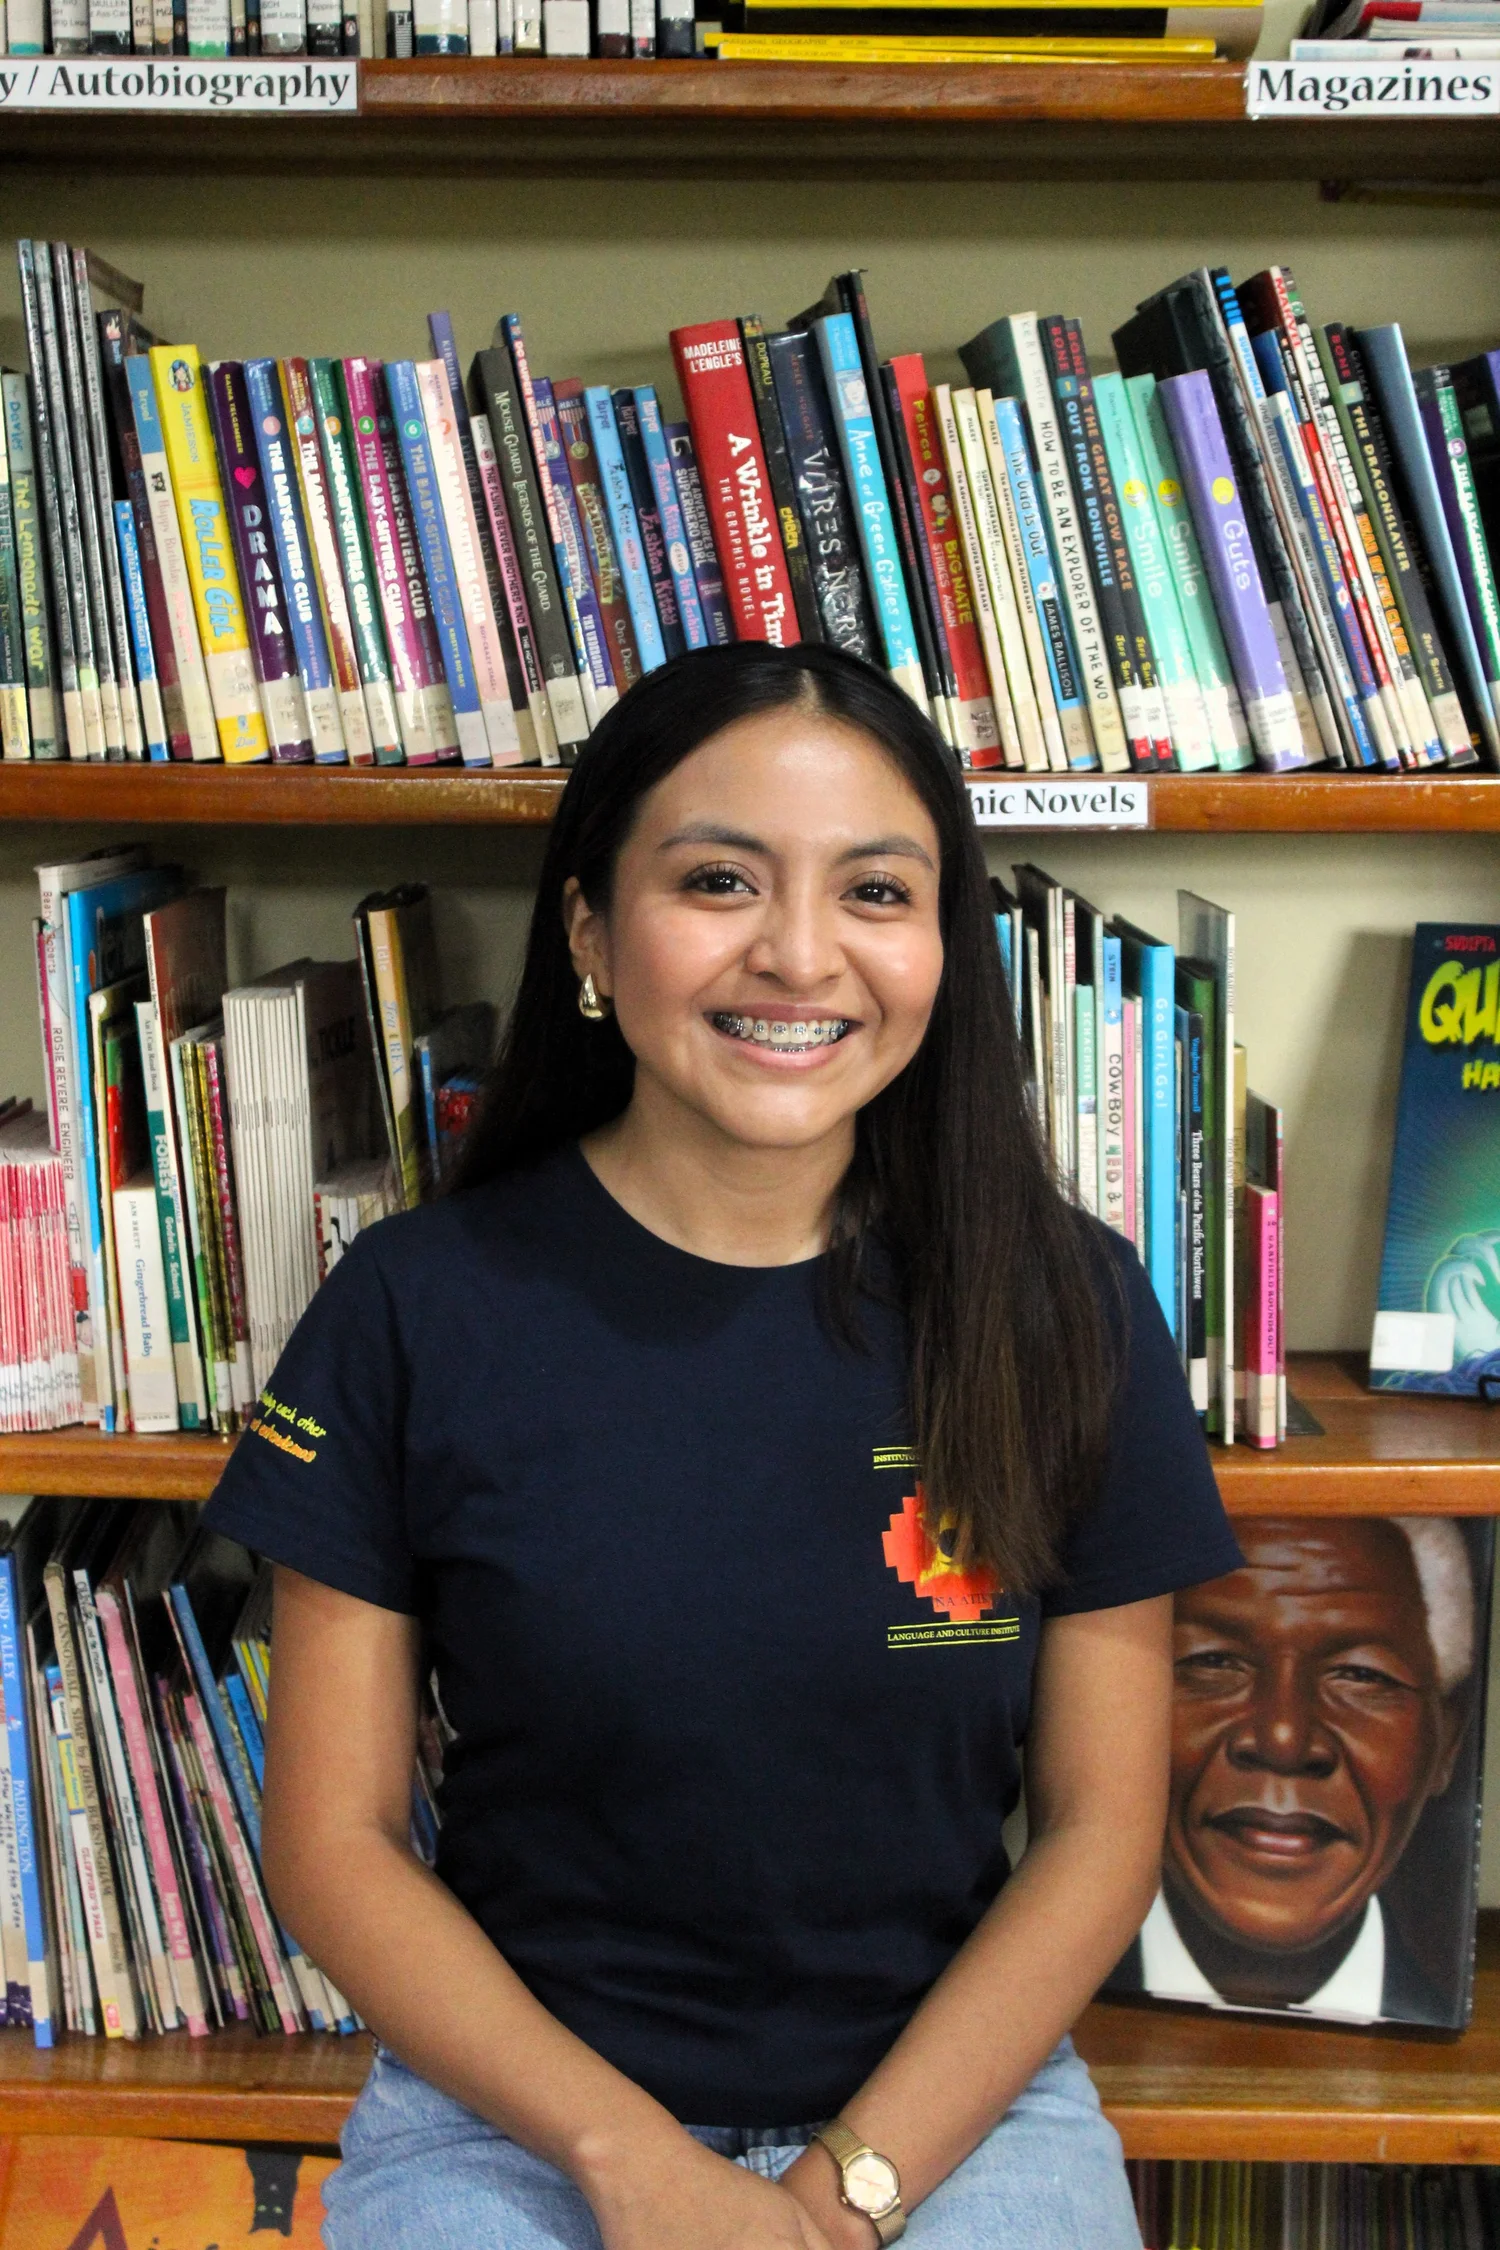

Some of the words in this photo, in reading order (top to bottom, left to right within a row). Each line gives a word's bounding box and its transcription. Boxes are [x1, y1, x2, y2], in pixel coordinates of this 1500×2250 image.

[48, 66, 350, 107] Autobiography
[1256, 67, 1491, 110] Magazines
[1273, 276, 1302, 350] MARVEL
[442, 339, 458, 390] KIBUISHI
[682, 336, 741, 359] MADELEINE
[688, 351, 742, 374] L'ENGLE'S
[1049, 324, 1069, 371] BONE
[1066, 330, 1085, 375] BONE
[1236, 335, 1263, 399] SUPERWOMAN
[1330, 333, 1351, 378] BONE
[137, 389, 153, 422] Bruel
[224, 373, 234, 400] RAINA
[8, 400, 25, 450] Davies
[180, 401, 200, 462] JAMIESON
[228, 402, 244, 454] TELGEMEIER
[493, 389, 517, 433] MOUSE
[640, 399, 660, 434] Harper
[911, 398, 935, 461] Peirce
[1063, 400, 1082, 436] OUT
[1297, 322, 1330, 401] SUPER
[1326, 417, 1362, 505] FRIENDS
[266, 440, 286, 471] THE
[728, 430, 751, 457] A
[848, 426, 877, 478] Anne
[1038, 420, 1057, 453] HOW
[409, 444, 426, 474] THE
[484, 466, 496, 483] THE
[685, 466, 699, 487] THE
[1072, 442, 1094, 490] FROM
[14, 477, 30, 497] The
[488, 483, 503, 517] FLYING
[512, 478, 536, 528] LEGENDS
[717, 477, 732, 502] THE
[732, 456, 773, 556] Wrinkle
[1050, 479, 1066, 499] BE
[1081, 404, 1099, 436] THE
[1090, 442, 1114, 502] GREAT
[1104, 507, 1122, 544] COW
[1113, 547, 1133, 591] RACE
[1350, 404, 1370, 439] THE
[1362, 443, 1410, 572] DRAGONSLAYER
[188, 494, 231, 581] ROLLER
[272, 472, 305, 579] BABY-SITTERS
[413, 476, 448, 584] BABY-SITTERS
[495, 519, 511, 553] BEAVER
[524, 528, 537, 544] OF
[673, 467, 700, 538] SUPERHERO
[690, 539, 706, 567] GIRL
[690, 487, 714, 549] ADVENTURES
[778, 506, 800, 549] EMBER
[862, 499, 893, 555] Green
[1016, 479, 1035, 510] Odd
[1027, 529, 1046, 558] Out
[1055, 505, 1072, 529] AN
[1306, 492, 1322, 518] KUNG
[1314, 518, 1329, 542] POW
[1322, 543, 1341, 583] CHICKEN
[527, 546, 542, 568] THE
[578, 487, 608, 563] HAZARDOUS
[594, 564, 614, 601] TALES
[638, 505, 667, 575] Fashion
[704, 551, 716, 563] OF
[723, 509, 746, 571] GRAPHIC
[1083, 495, 1114, 586] BONEVILLE
[1134, 521, 1164, 598] Smile
[1168, 520, 1198, 596] Smile
[1224, 520, 1252, 592] Guts
[17, 517, 40, 616] Lemonade
[241, 502, 283, 636] DRAMA
[503, 554, 521, 603] BROTHERS
[678, 577, 693, 596] the
[753, 563, 778, 589] in
[875, 556, 906, 616] Gables
[931, 542, 951, 590] STRIKES
[941, 593, 958, 628] AGAIN
[1061, 534, 1090, 611] EXPLORER
[122, 532, 136, 575] GARFIELD
[133, 610, 147, 648] WEIGHT
[292, 580, 312, 623] CLUB
[435, 584, 456, 627] CLUB
[530, 568, 554, 611] GUARD
[652, 579, 677, 626] Kitty
[737, 576, 756, 620] NOVEL
[950, 576, 973, 625] NATE
[513, 605, 525, 624] AND
[613, 619, 629, 645] One
[681, 597, 703, 644] Fashion
[711, 610, 727, 638] FAITH
[1043, 600, 1062, 639] JAMES
[1079, 616, 1095, 636] OF
[618, 647, 636, 680] Dead
[1085, 643, 1104, 671] THE
[1112, 633, 1128, 657] JEFF
[1420, 631, 1435, 655] JEFF
[1428, 656, 1446, 690] SMITH
[1052, 640, 1075, 697] RALLISON
[1024, 786, 1136, 814] Novels
[39, 890, 54, 921] Beaty
[376, 944, 389, 971] Idle
[1154, 998, 1166, 1022] Go
[1418, 959, 1500, 1045] QU
[389, 1042, 404, 1076] REX
[1082, 1011, 1091, 1088] SCHACHNER
[51, 1027, 65, 1061] ROSIE
[58, 1122, 74, 1180] ENGINEER
[1105, 1053, 1122, 1136] COWBOY
[1155, 1074, 1168, 1108] Go!
[153, 1134, 173, 1198] FOREST
[1191, 1130, 1202, 1160] Three
[1191, 1162, 1202, 1187] Bears
[1193, 1190, 1201, 1199] of
[1193, 1200, 1201, 1210] the
[1193, 1213, 1203, 1244] Pacific
[1192, 1246, 1204, 1299] Northwest
[1266, 1235, 1274, 1287] GARFIELD
[131, 1258, 150, 1328] Gingerbread
[138, 1332, 152, 1358] Baby
[0, 1576, 10, 1619] BOND
[0, 1634, 15, 1680] ALLEY
[55, 1610, 80, 1702] CANNONBALL
[887, 1629, 935, 1642] LANGUAGE
[936, 1630, 954, 1638] AND
[955, 1628, 990, 1636] CULTURE
[70, 1707, 87, 1741] SIMP
[75, 1744, 89, 1760] by
[78, 1762, 97, 1804] JOHN
[12, 1779, 32, 1873] PADDINGTON
[5, 1843, 18, 1864] and
[7, 1868, 20, 1890] the
